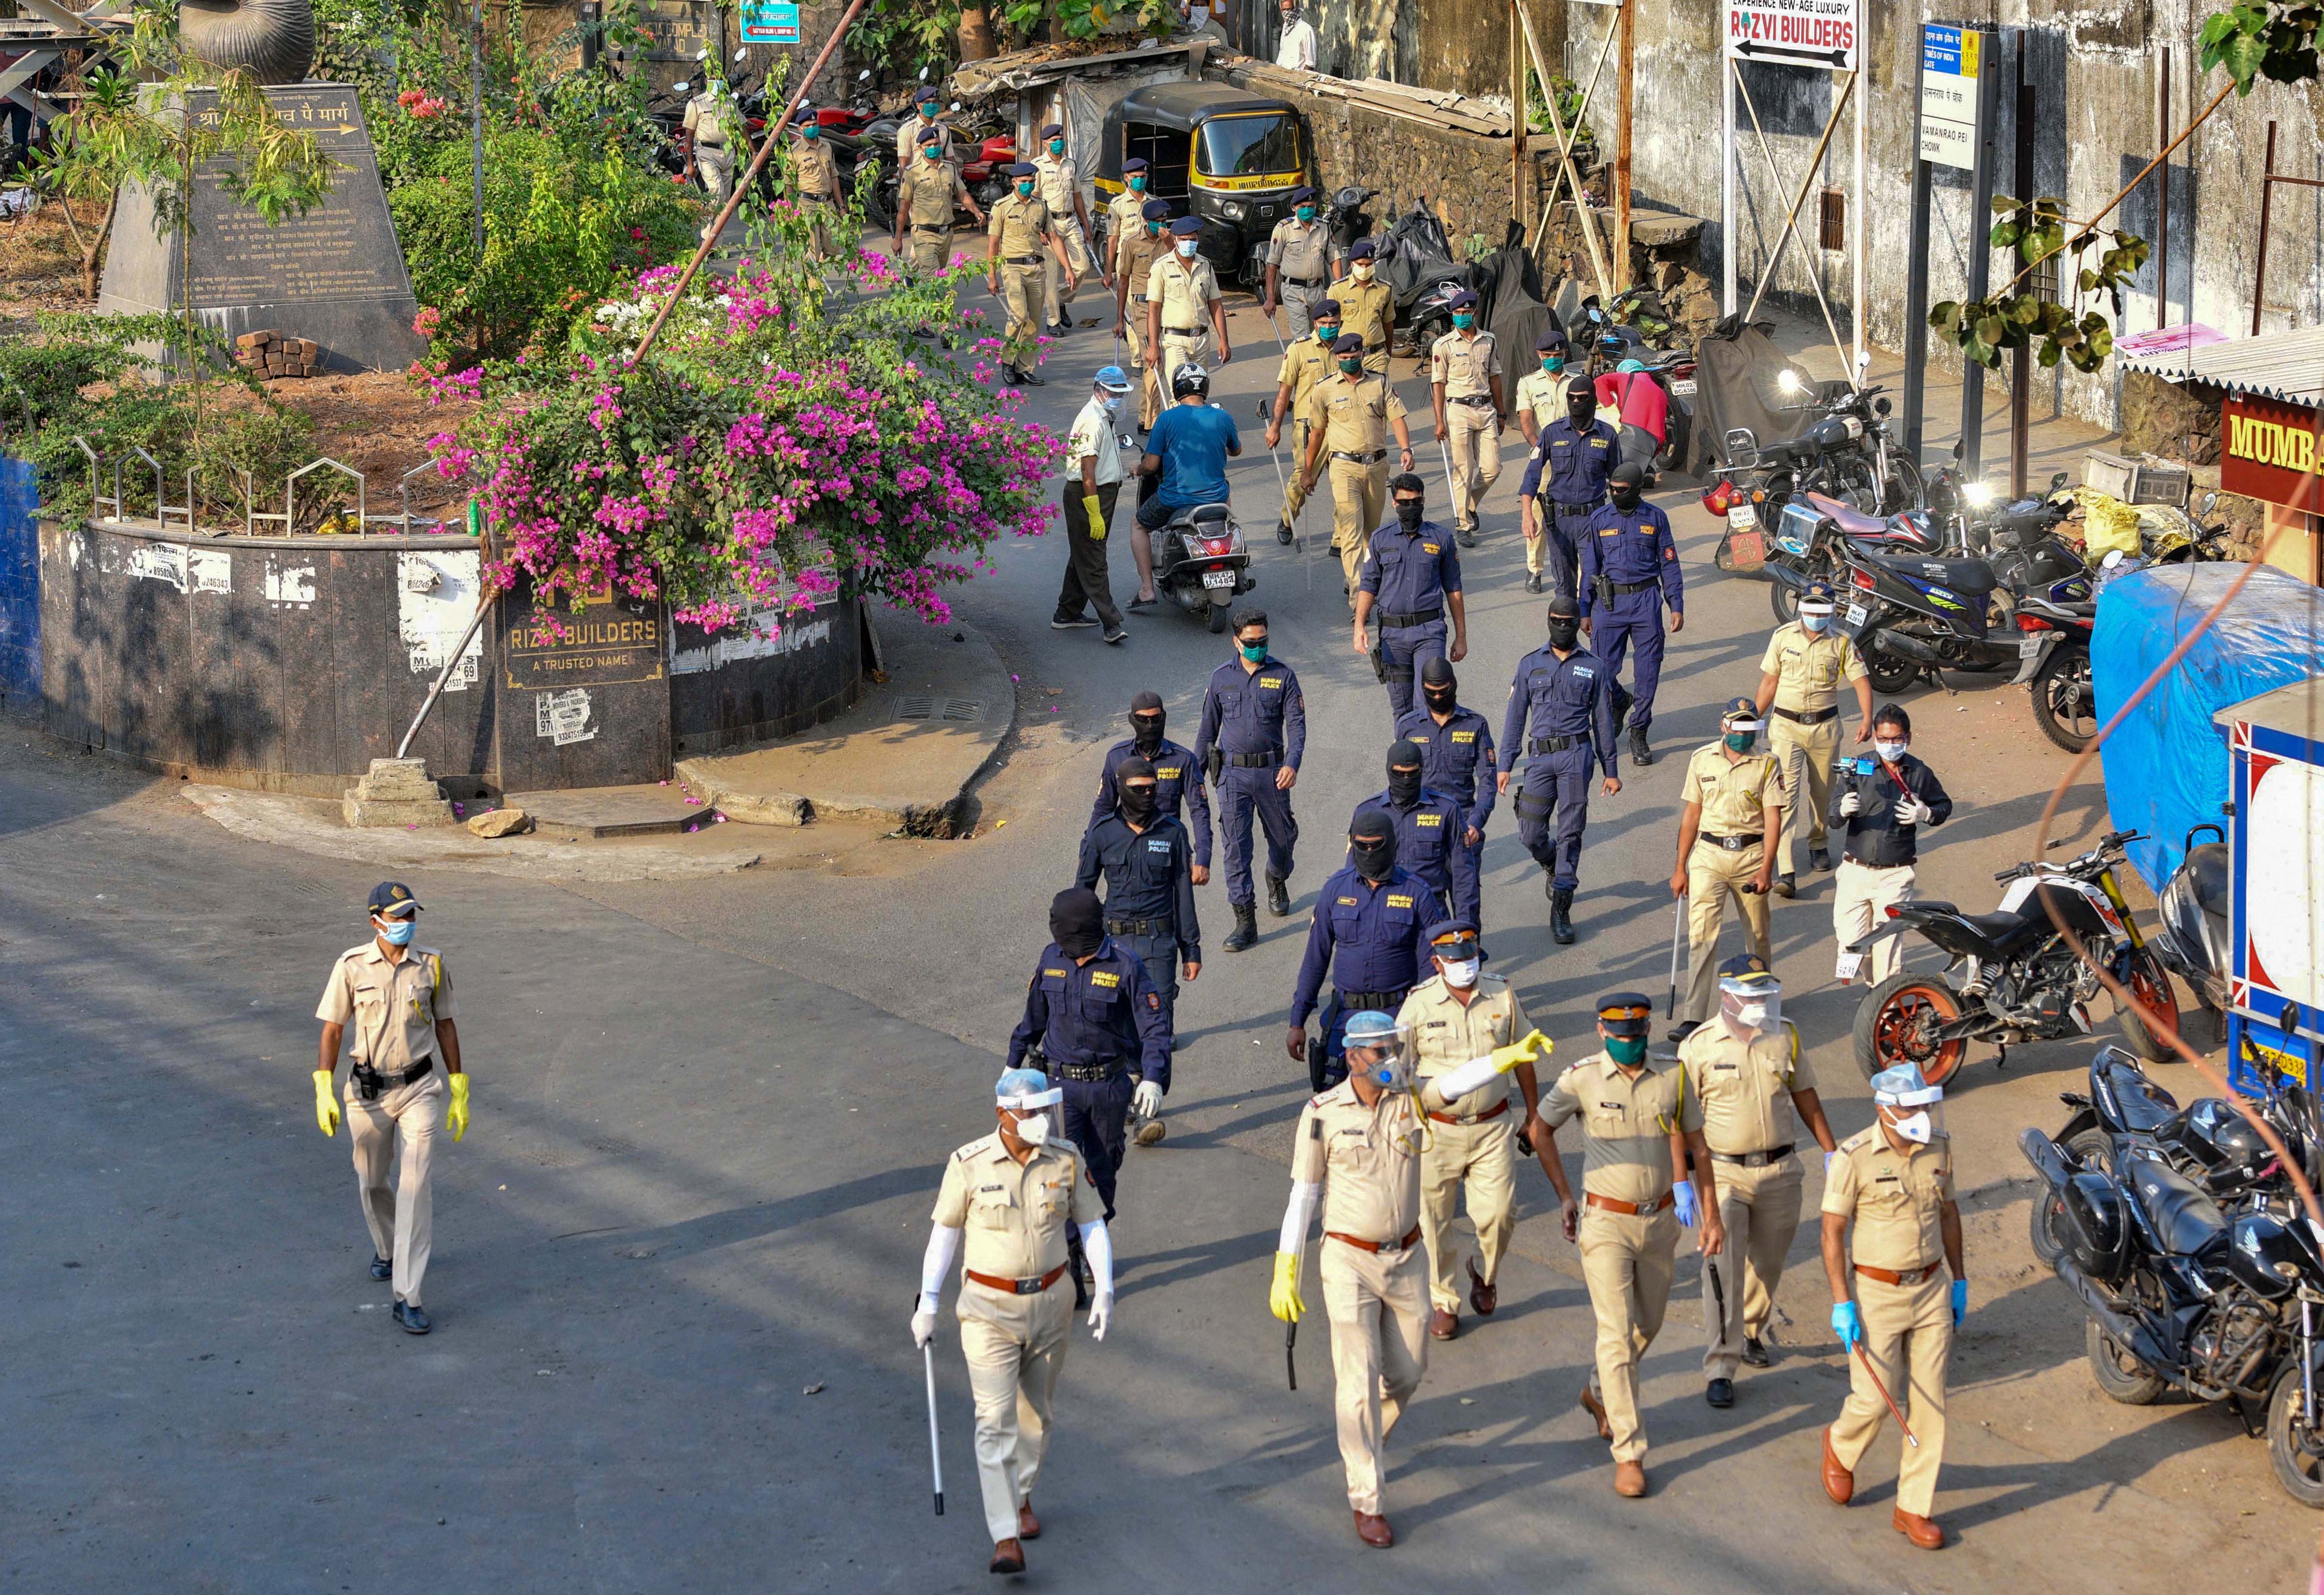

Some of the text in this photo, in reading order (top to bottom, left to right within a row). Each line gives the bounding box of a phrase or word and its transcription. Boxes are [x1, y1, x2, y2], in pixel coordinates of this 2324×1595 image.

[1779, 0, 1813, 12] NEW-AGE
[1816, 4, 1850, 15] LUXURY
[1731, 11, 1853, 49] RIZVI BUILDERS
[1925, 49, 1936, 59] TIMES
[1937, 51, 1943, 60] OF
[1943, 53, 1955, 62] INDIA
[1925, 60, 1935, 69] GATE
[300, 102, 313, 122] पै
[318, 102, 348, 122] मार्ग
[1922, 125, 1968, 143] VAMANRAO PEI
[1921, 140, 1940, 153] CHOWK
[511, 620, 656, 649] RIZ BUILDERS
[533, 655, 628, 672] A TRUSTED NAME
[558, 728, 589, 741] 93247515
[1148, 839, 1171, 847] MUMBAI
[1091, 978, 1117, 987] POLICE
